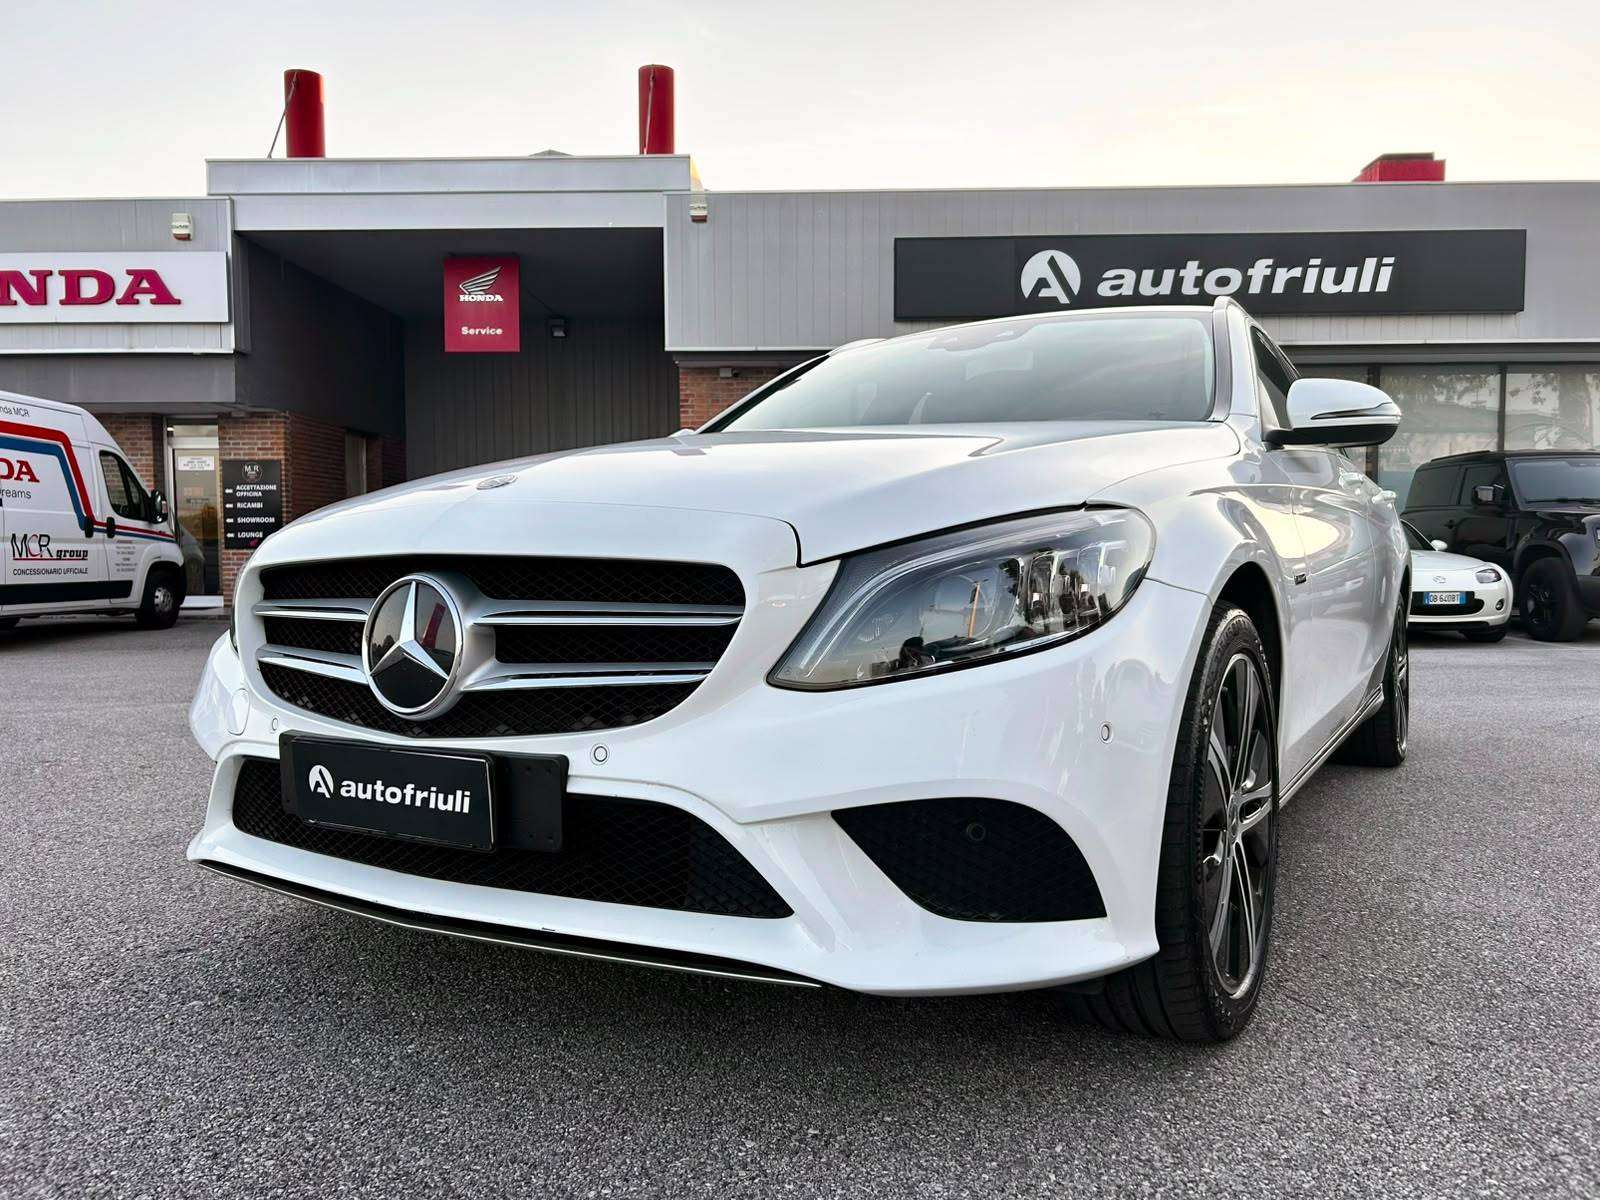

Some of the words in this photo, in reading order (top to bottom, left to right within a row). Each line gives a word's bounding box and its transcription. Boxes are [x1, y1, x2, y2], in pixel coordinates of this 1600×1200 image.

[1096, 256, 1396, 297] autofriuli
[0, 269, 182, 306] NDA
[459, 294, 504, 302] HONDA
[461, 326, 503, 335] Service
[0, 406, 12, 415] nda
[12, 407, 30, 417] MCR
[0, 457, 40, 483] DA
[0, 488, 31, 499] reams
[10, 533, 52, 558] MCR
[56, 549, 88, 560] group
[13, 568, 62, 576] CONCESSIONARIO
[63, 567, 88, 575] UFFICIALE
[339, 779, 471, 814] autofriuli
